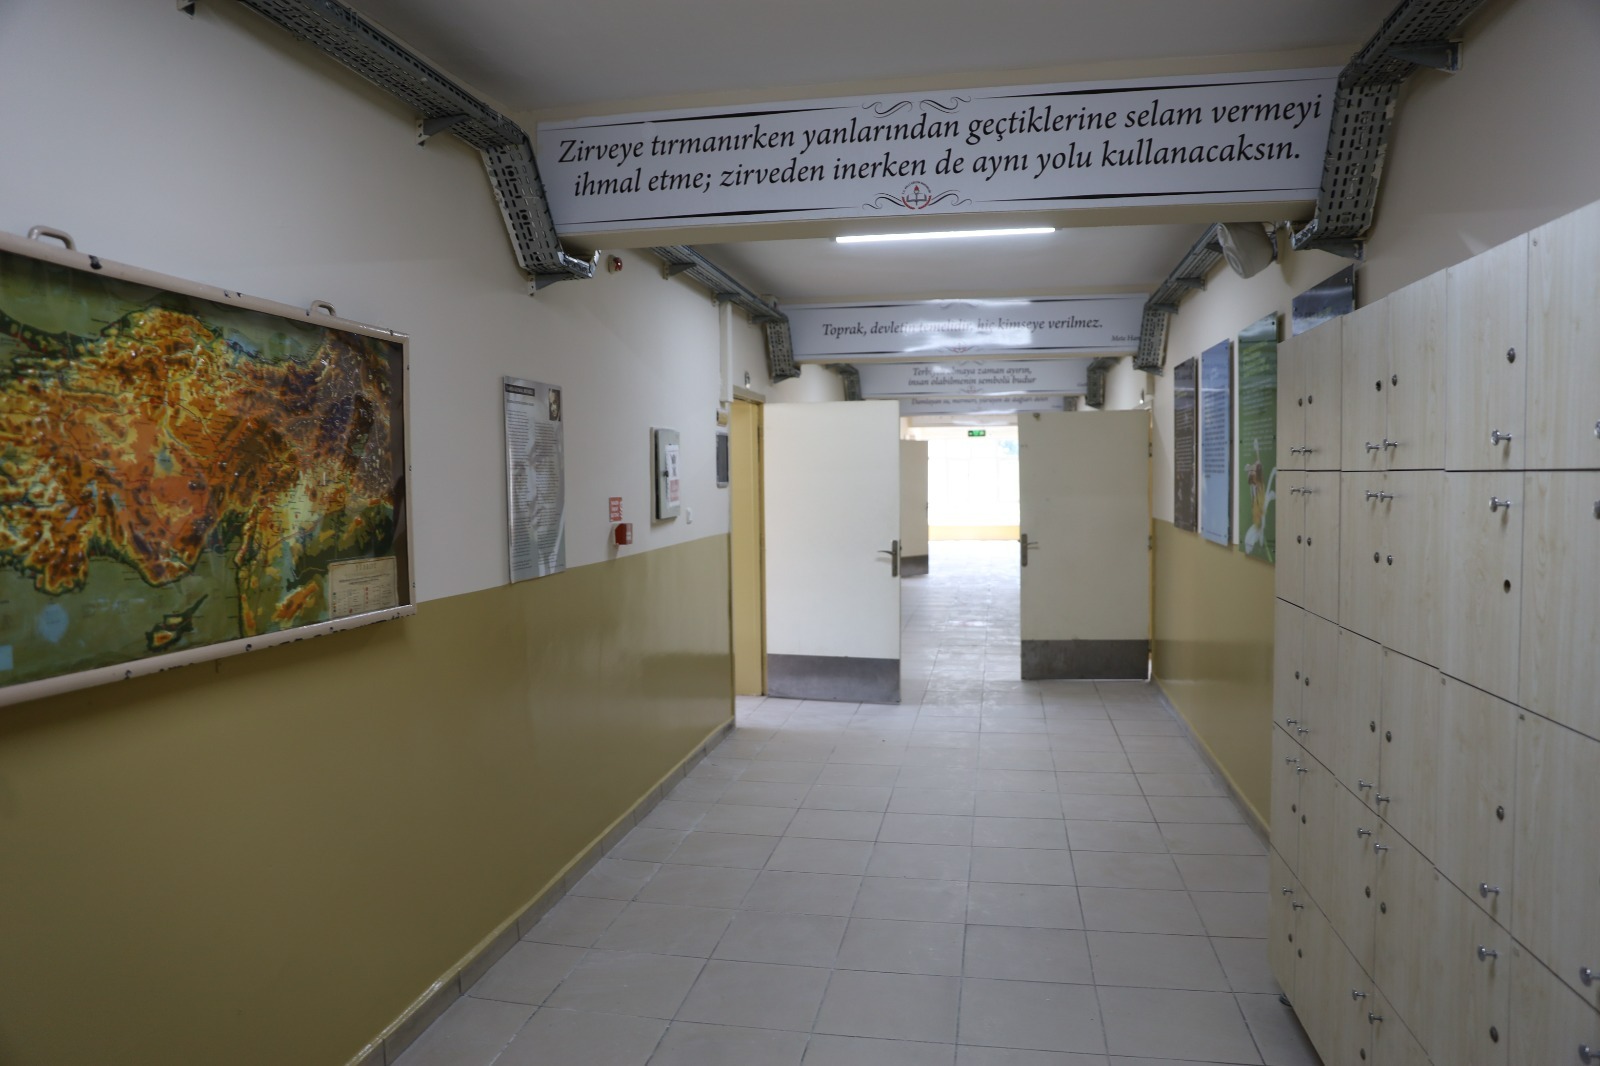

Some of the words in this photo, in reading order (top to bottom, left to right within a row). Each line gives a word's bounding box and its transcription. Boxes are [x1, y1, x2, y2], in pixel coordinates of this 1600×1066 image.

[557, 139, 644, 168] Zirveye
[651, 123, 795, 157] tırmanırken
[799, 112, 960, 155] yanlarından
[965, 104, 1117, 146] geçtiklerine
[1124, 98, 1203, 129] selam
[1211, 93, 1322, 130] vermeyi
[574, 167, 642, 197] ihmal
[648, 169, 712, 194] etme;
[719, 156, 825, 188] zirveden
[833, 151, 927, 181] inerken
[935, 147, 965, 175] de
[972, 154, 1029, 182] aynı
[1033, 141, 1093, 180] yolu
[1101, 133, 1301, 168] kullanacaksın.
[822, 322, 867, 339] Toprak,
[998, 317, 1045, 333] kimseye
[1048, 315, 1104, 330] verilmez.
[908, 376, 929, 386] insan
[977, 367, 1005, 375] zaman
